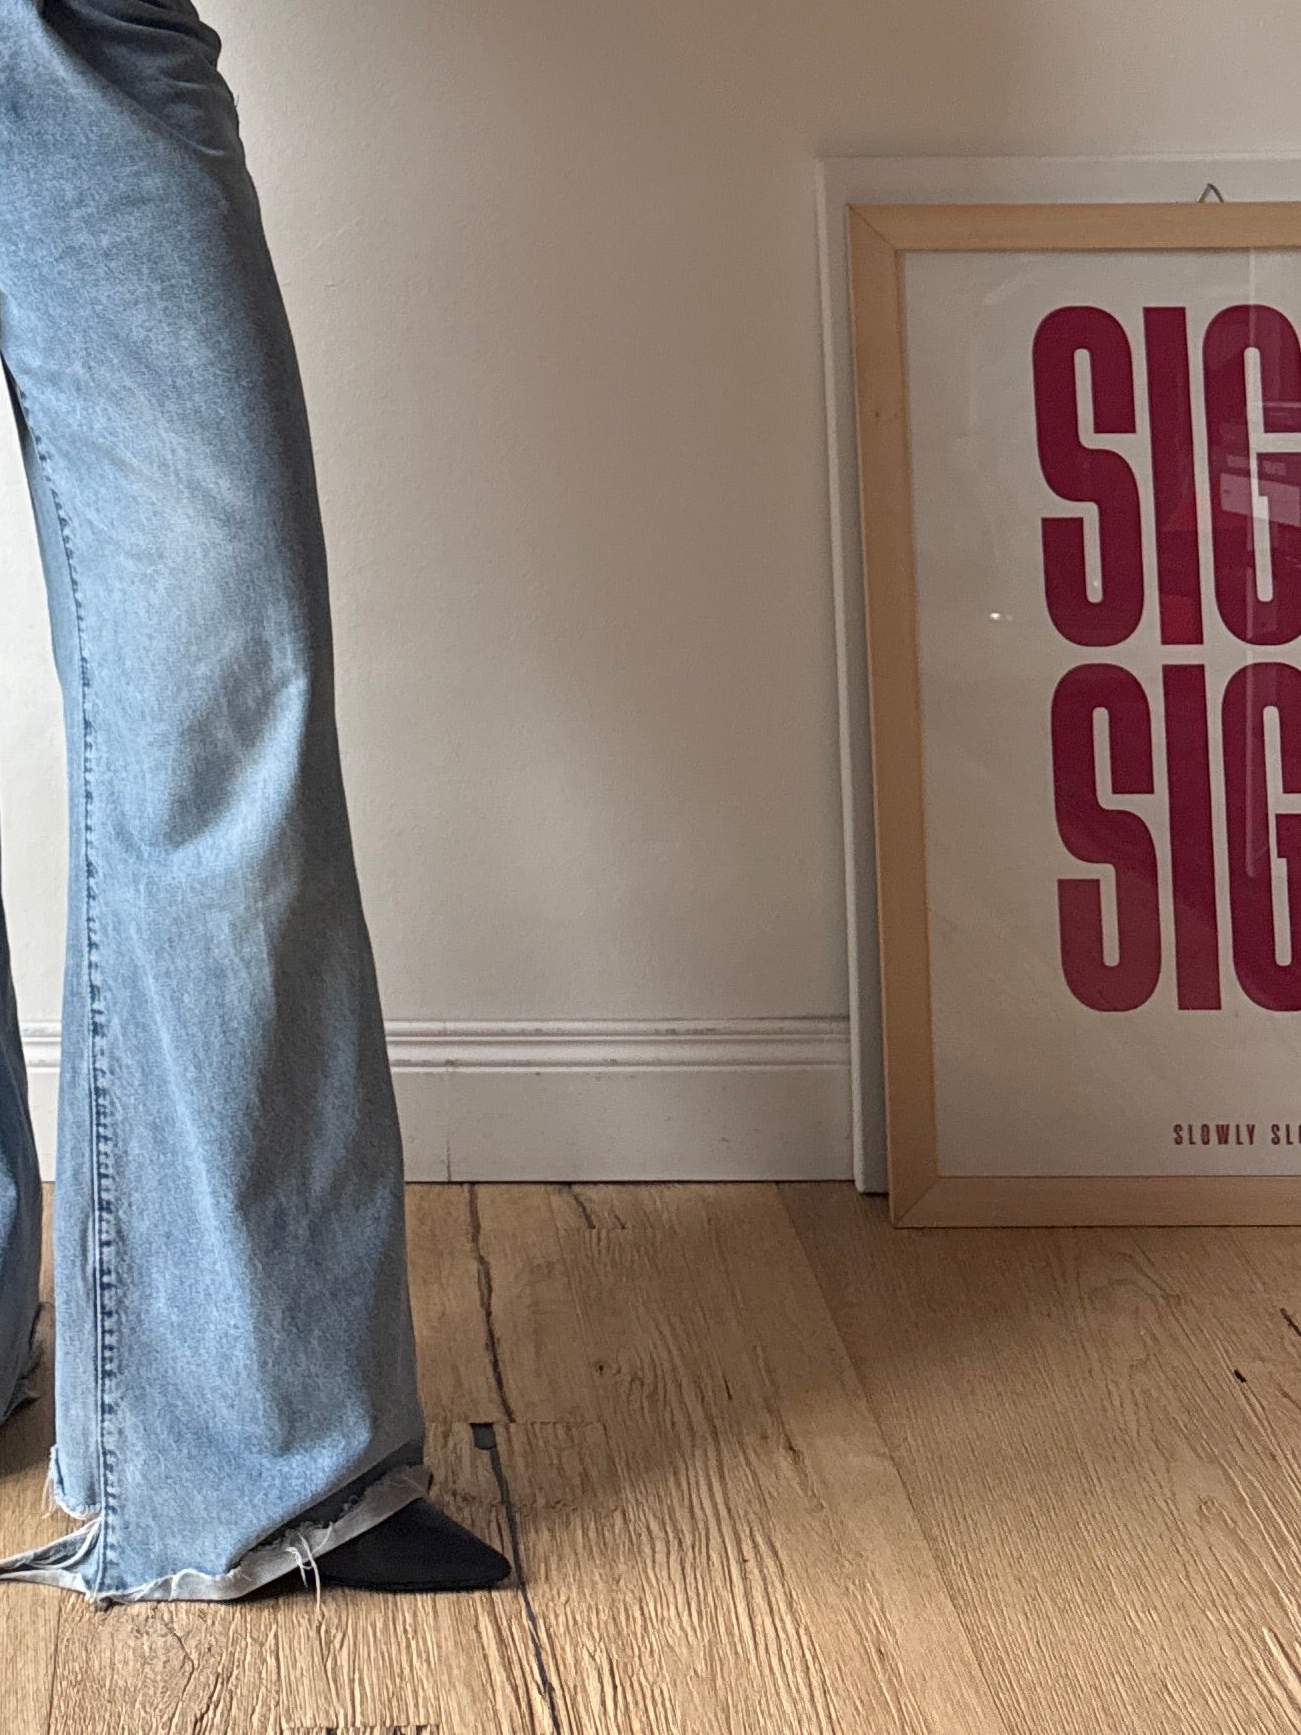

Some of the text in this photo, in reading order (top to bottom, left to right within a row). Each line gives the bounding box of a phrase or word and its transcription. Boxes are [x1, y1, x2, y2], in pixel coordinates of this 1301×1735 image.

[1032, 304, 1301, 647] SIG
[1051, 662, 1301, 1012] SIG
[1173, 1123, 1256, 1146] SLOWLY
